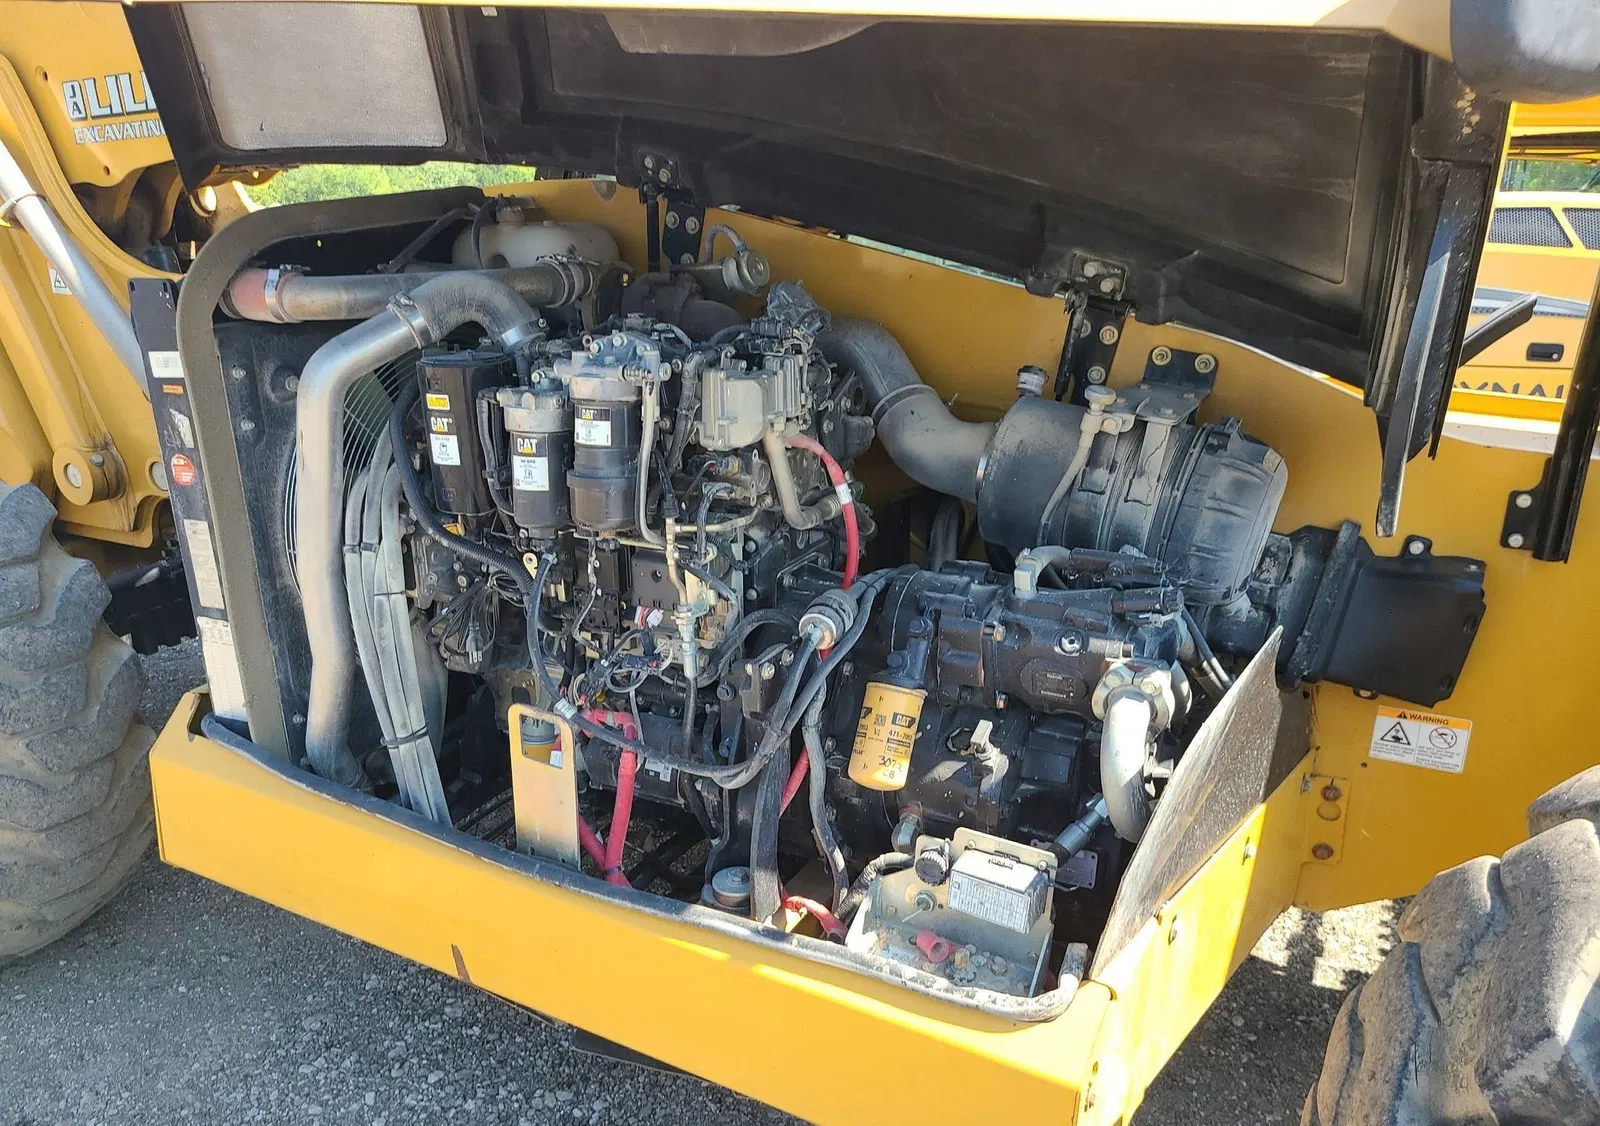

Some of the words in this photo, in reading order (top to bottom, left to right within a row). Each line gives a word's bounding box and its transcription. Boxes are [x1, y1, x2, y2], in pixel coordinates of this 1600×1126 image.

[517, 437, 538, 454] CAT
[896, 715, 911, 728] CAT
[1409, 712, 1449, 726] WARNING
